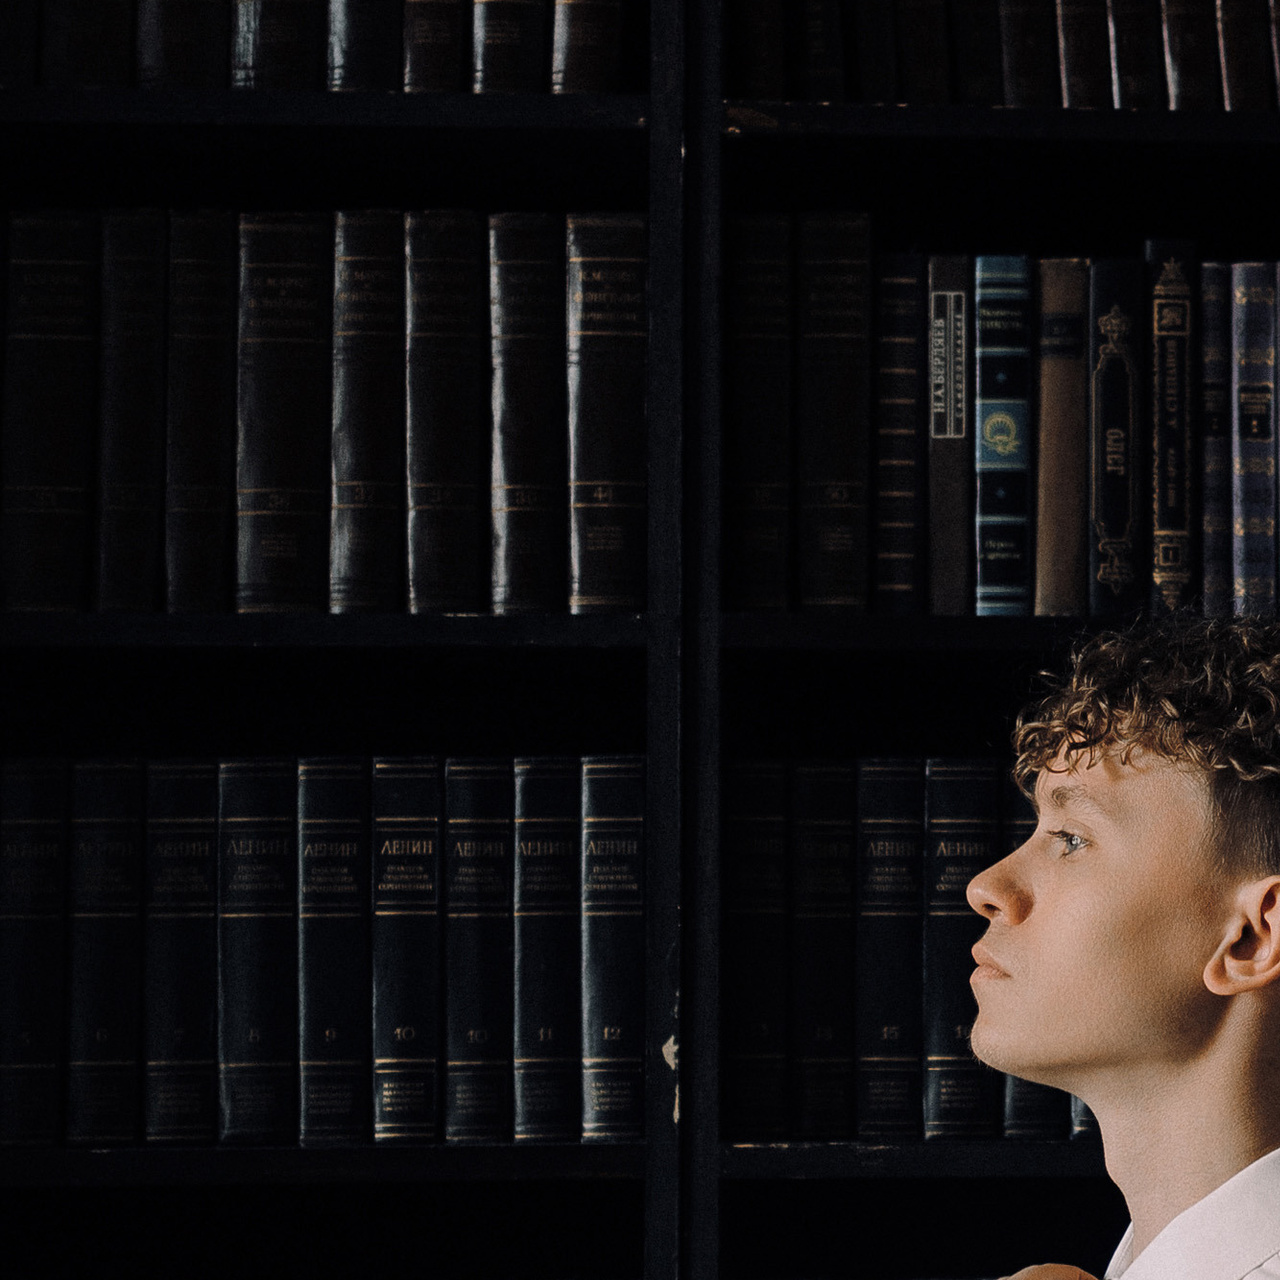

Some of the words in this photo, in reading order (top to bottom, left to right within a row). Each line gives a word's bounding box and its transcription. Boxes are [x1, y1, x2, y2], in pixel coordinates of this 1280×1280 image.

[1105, 426, 1127, 477] ОЛЕГ
[303, 841, 359, 858] ЛЕНИН
[379, 838, 435, 857] ЛЕНИН
[453, 840, 506, 857] ЛЕНИН
[587, 839, 640, 856] ЛЕНИН
[864, 840, 916, 858] ЛЕНИН
[323, 1026, 337, 1043] 9
[392, 1025, 417, 1042] 10
[466, 1028, 489, 1044] 10
[537, 1025, 553, 1042] 11
[602, 1024, 624, 1042] 12
[880, 1024, 901, 1041] 15
